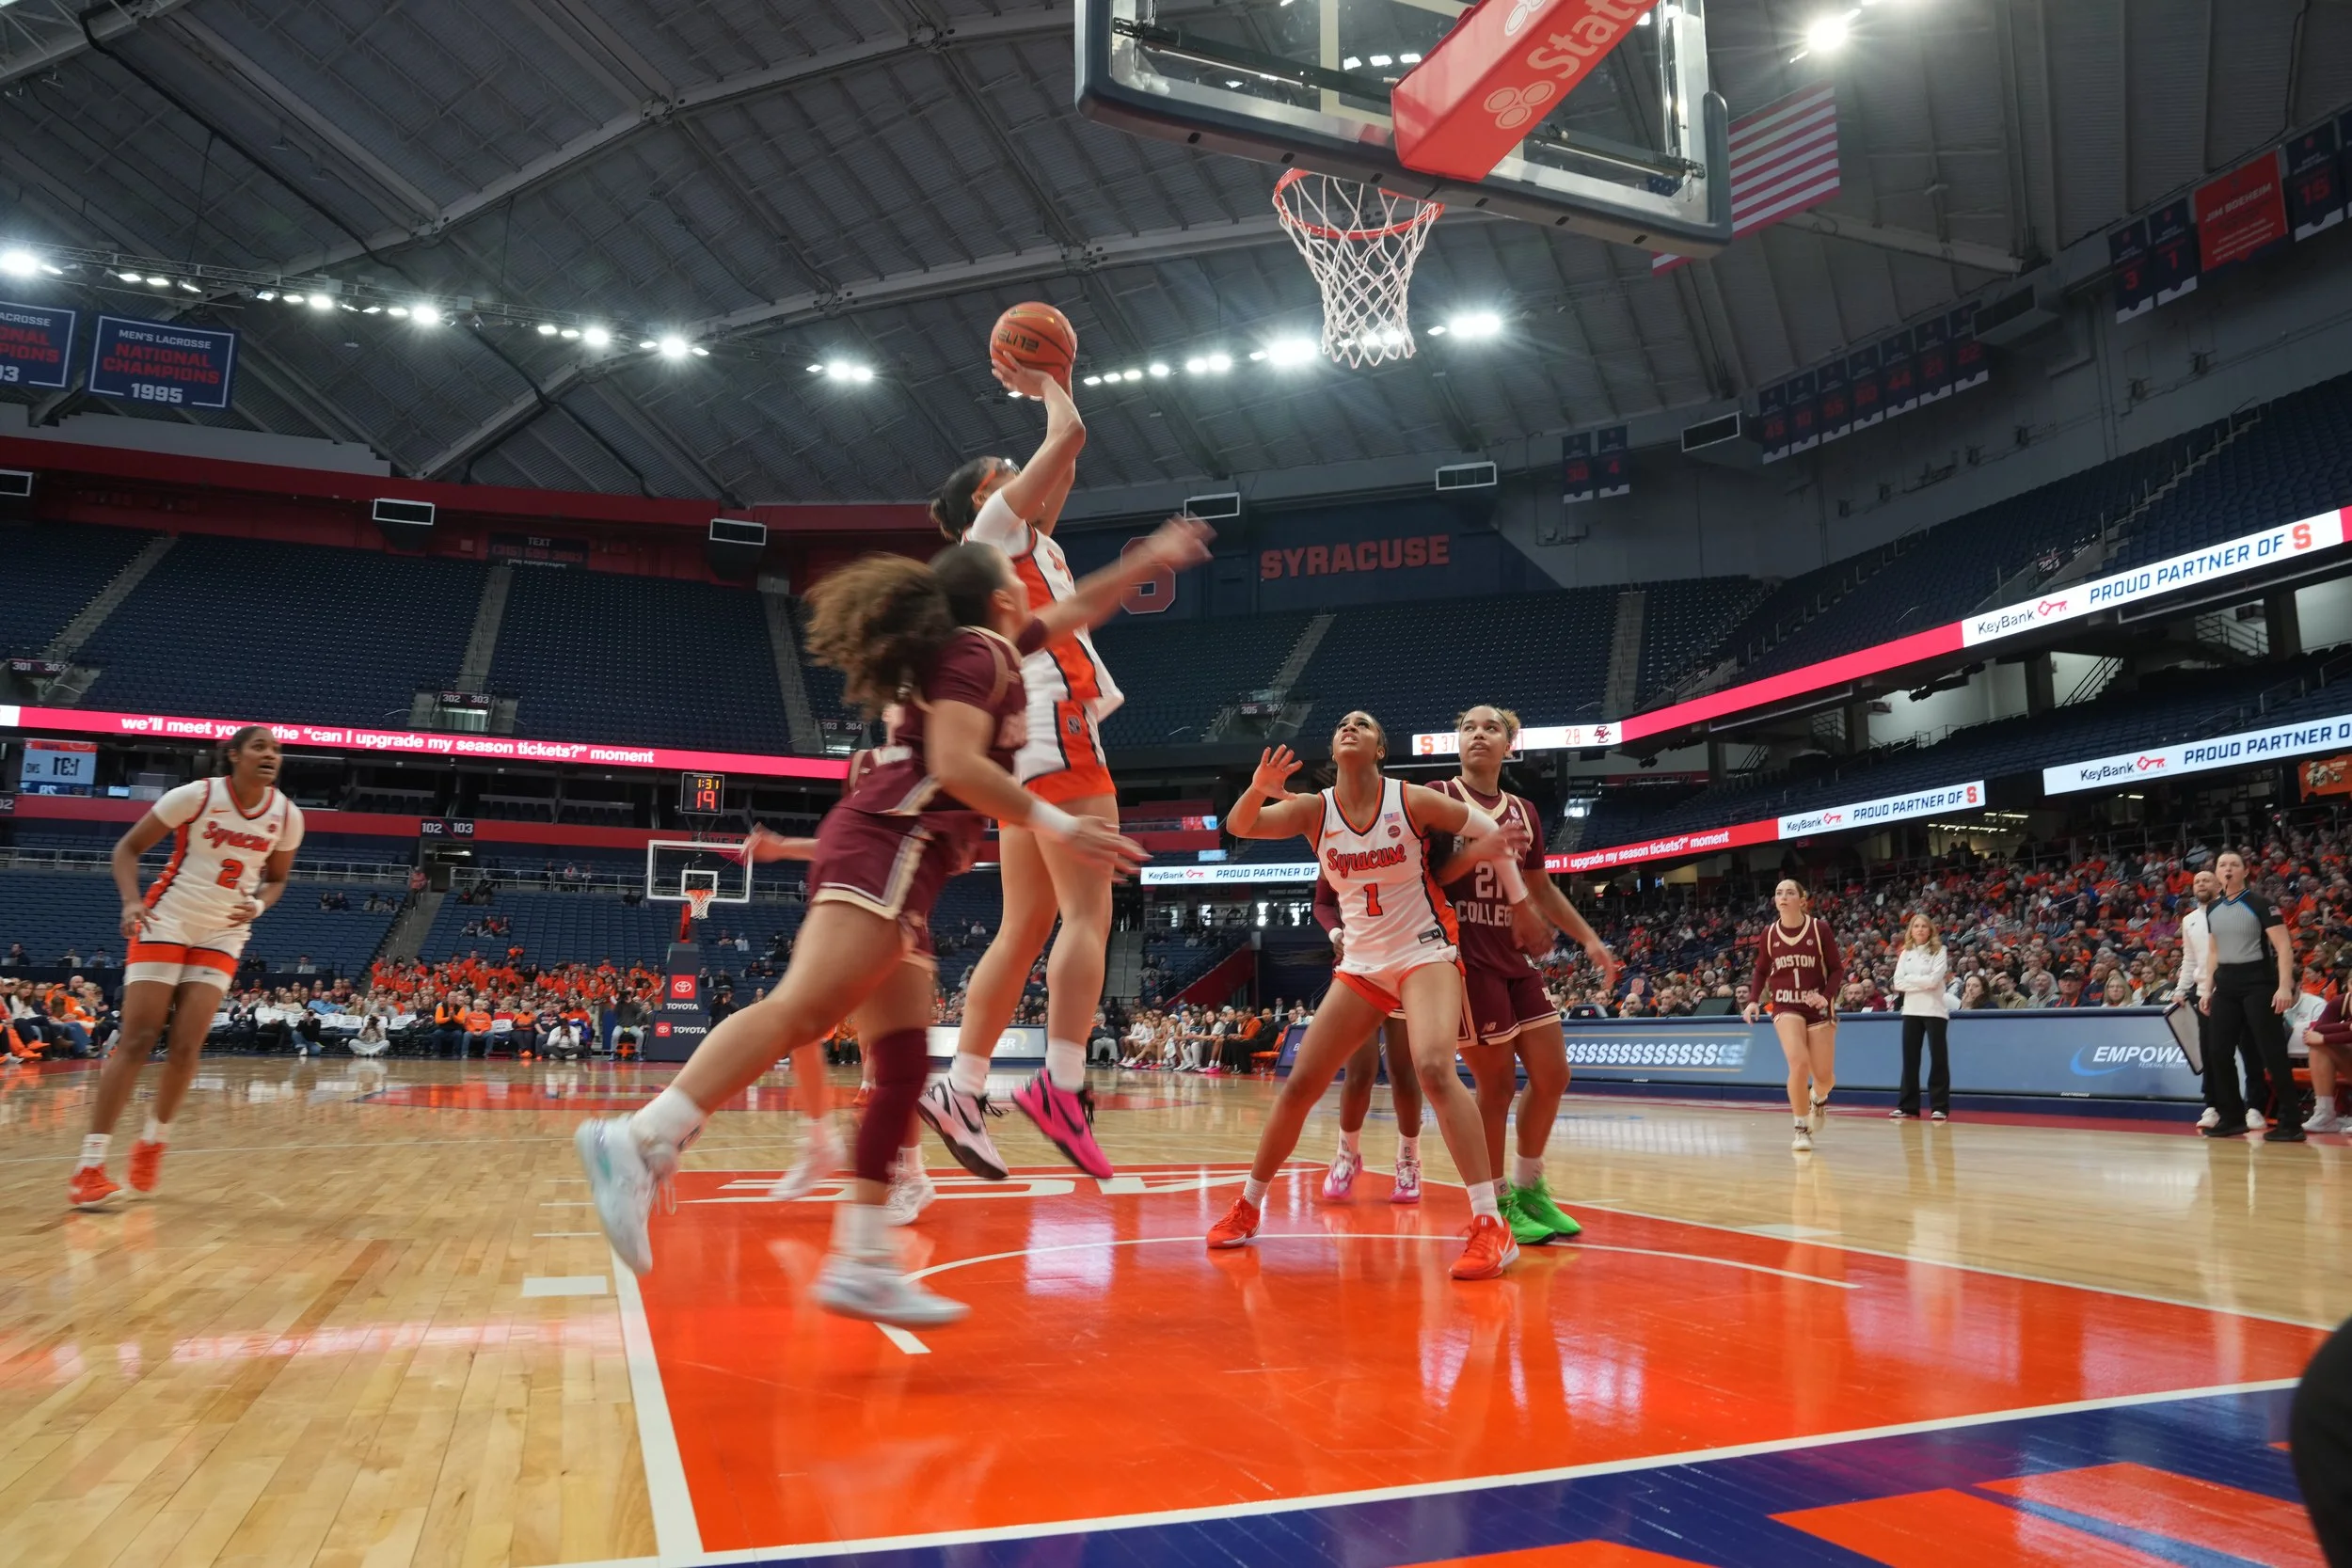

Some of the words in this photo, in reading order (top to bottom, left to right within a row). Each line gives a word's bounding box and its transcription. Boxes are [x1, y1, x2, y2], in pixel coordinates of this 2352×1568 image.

[119, 328, 154, 342] MEN'S
[156, 333, 212, 350] LACROSSE
[115, 341, 212, 368] NATIONAL
[102, 356, 220, 385] CHAMPIONS
[131, 382, 183, 404] 1995
[1260, 534, 1451, 580] SYRACUSE
[1977, 606, 2035, 636] KeyBank
[2090, 573, 2152, 605] PROUD
[2156, 546, 2250, 585] PARTNER
[2258, 533, 2286, 557] OF
[12, 662, 31, 672] 301
[442, 694, 461, 704] 302
[470, 695, 489, 705] 303
[167, 720, 212, 735] meet
[215, 724, 242, 738] yo
[271, 725, 299, 740] the
[345, 730, 353, 744] I
[356, 735, 424, 750] upgrade
[427, 737, 453, 752] my
[456, 739, 514, 753] season
[590, 748, 655, 764] moment
[1565, 729, 1581, 745] 28
[2080, 761, 2135, 782] KeyBank
[2184, 741, 2241, 765] PROUD
[2247, 727, 2332, 754] PARTNER
[696, 778, 721, 790] 1:31
[695, 790, 717, 811] 19
[1787, 816, 1822, 832] KeyBank
[1853, 804, 1890, 821] PROUD
[1892, 794, 1945, 815] PARTNER
[1947, 790, 1964, 804] OF
[421, 822, 443, 834] 102
[453, 822, 474, 834] 103
[1327, 843, 1407, 879] Syracuse
[1570, 852, 1604, 869] upgrade
[1605, 851, 1617, 863] my
[1618, 847, 1649, 861] season
[1690, 831, 1730, 847] moment
[215, 858, 245, 890] 2
[1147, 871, 1185, 880] KeyBank
[1216, 869, 1251, 879] PROUD
[1253, 867, 1301, 878] PARTNER
[1303, 867, 1317, 877] OF
[1363, 882, 1384, 918] 1
[1774, 955, 1816, 969] BOSTON
[1792, 967, 1801, 989] 1
[1775, 989, 1820, 1004] COLLE
[673, 1026, 707, 1035] TOYOTA
